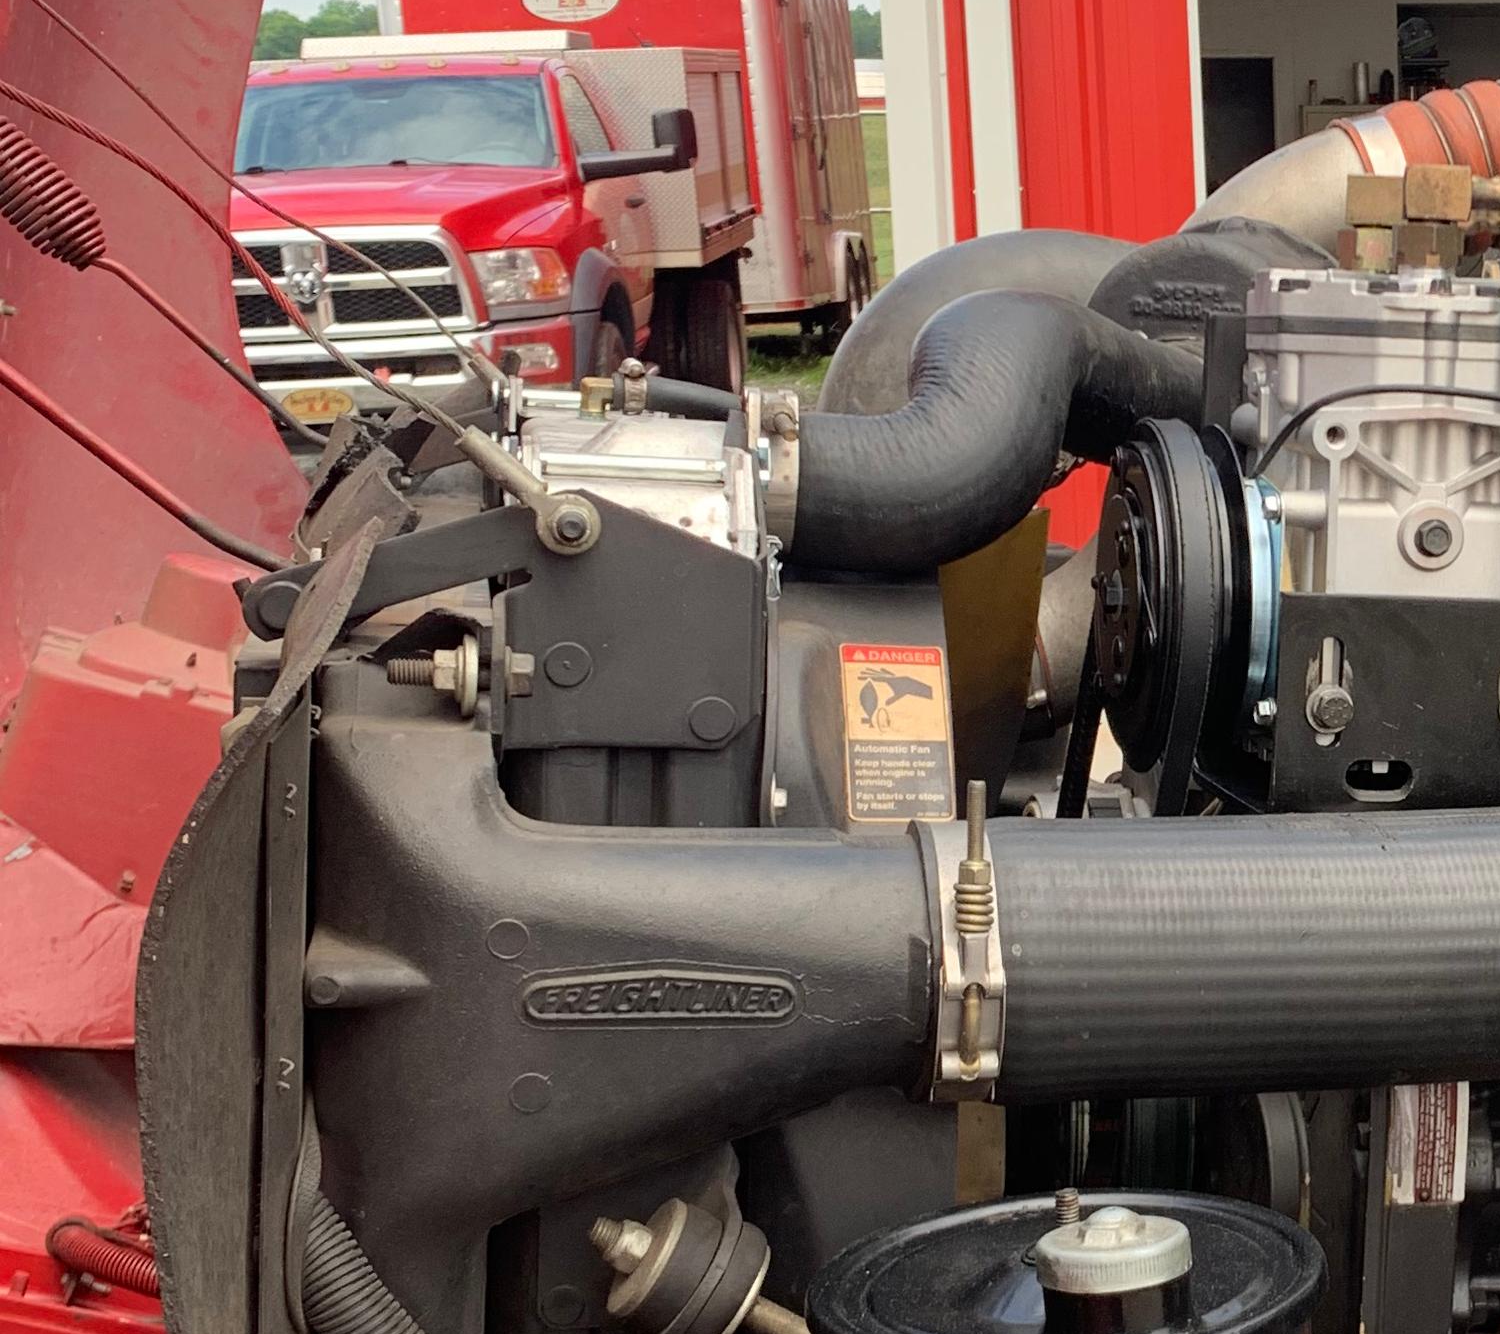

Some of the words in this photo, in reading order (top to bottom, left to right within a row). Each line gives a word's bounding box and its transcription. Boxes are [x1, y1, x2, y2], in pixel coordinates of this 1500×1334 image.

[869, 650, 936, 663] DANGER
[854, 744, 908, 754] Automatic
[910, 745, 931, 754] Fan
[854, 759, 880, 769] Keep
[880, 759, 911, 768] hands
[912, 759, 936, 768] clear
[855, 769, 881, 777] when
[882, 769, 915, 779] engine
[916, 769, 926, 777] is
[856, 792, 874, 800] Fan
[876, 792, 904, 800] starts
[918, 793, 945, 802] stops
[856, 802, 869, 811] by
[537, 979, 787, 1014] FREIGHTLINER
